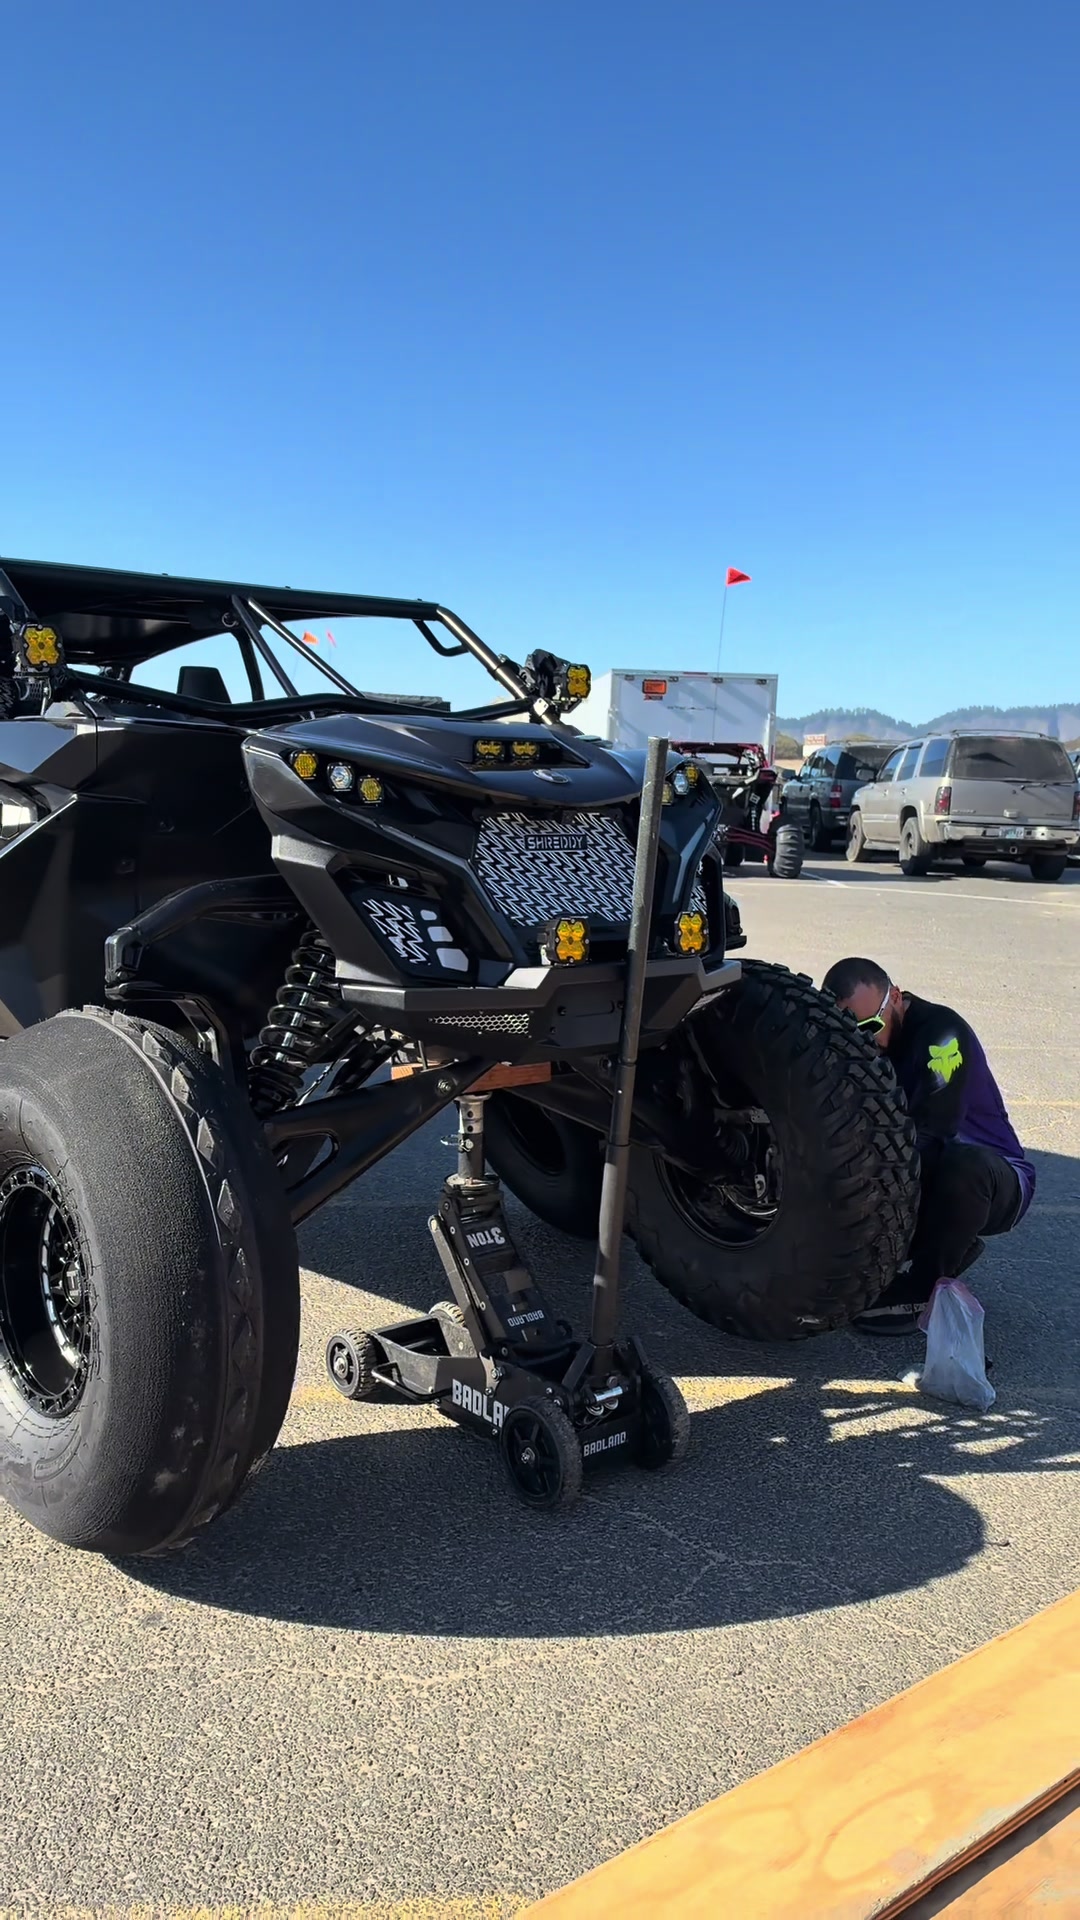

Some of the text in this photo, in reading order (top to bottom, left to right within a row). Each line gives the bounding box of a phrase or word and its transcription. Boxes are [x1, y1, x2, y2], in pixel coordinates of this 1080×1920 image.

[527, 836, 584, 849] SHREDDY
[507, 1309, 544, 1327] BADLAND
[452, 1378, 510, 1427] BADLA
[584, 1431, 627, 1457] BADLAND
